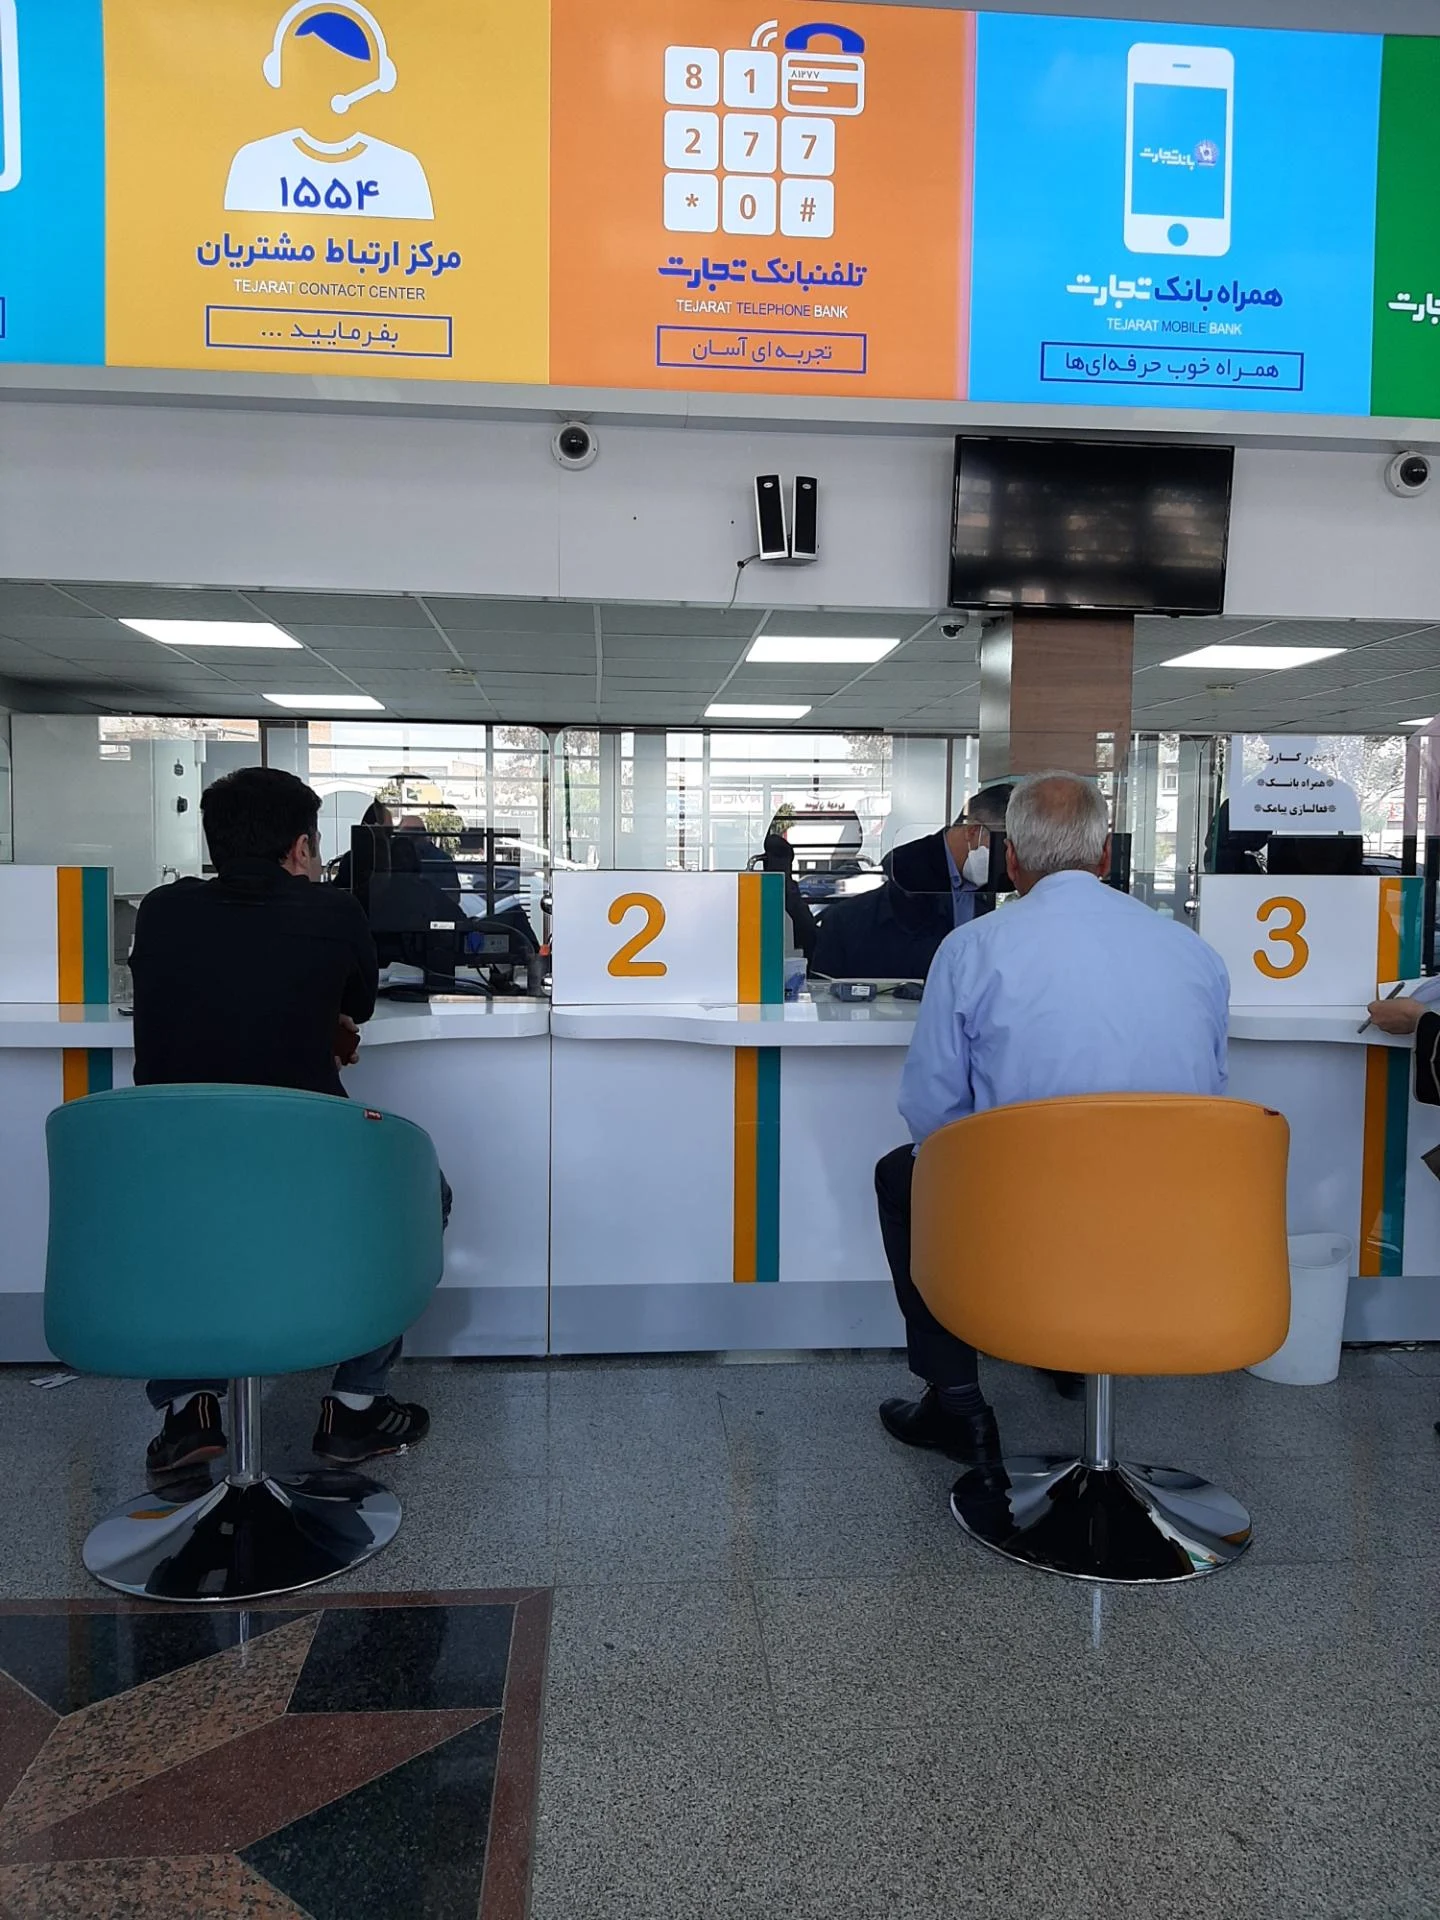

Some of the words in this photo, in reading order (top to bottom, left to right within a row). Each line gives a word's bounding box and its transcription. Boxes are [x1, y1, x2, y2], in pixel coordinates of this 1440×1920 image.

[686, 64, 702, 89] 8
[743, 68, 756, 94] 1
[685, 129, 700, 153] 2
[744, 132, 758, 156] 7
[802, 135, 816, 159] 7
[281, 177, 379, 210] ۱۵۵۴
[740, 194, 756, 219] 0
[197, 232, 315, 268] مشتریان
[325, 238, 399, 274] ارتباط
[404, 241, 461, 277] مرکز
[659, 257, 746, 291] تجارت
[234, 279, 295, 294] TEJARAT
[300, 283, 365, 296] CONTACT
[370, 285, 424, 300] CENTER
[1067, 275, 1152, 308] تجارت
[1155, 276, 1212, 311] بانک
[1218, 281, 1282, 311] همراه
[676, 299, 732, 315] TEJARAT
[736, 301, 811, 317] TELEPHONE
[815, 305, 847, 318] BANK
[1108, 318, 1158, 330] TEJARAT
[1162, 321, 1206, 333] MOBILE
[1209, 322, 1242, 335] BANK
[693, 337, 748, 360] آسان
[775, 345, 832, 365] تجربه
[1166, 357, 1210, 380] خوب
[1216, 359, 1278, 381] همراه
[608, 893, 667, 977] 2
[1254, 896, 1309, 979] 3
